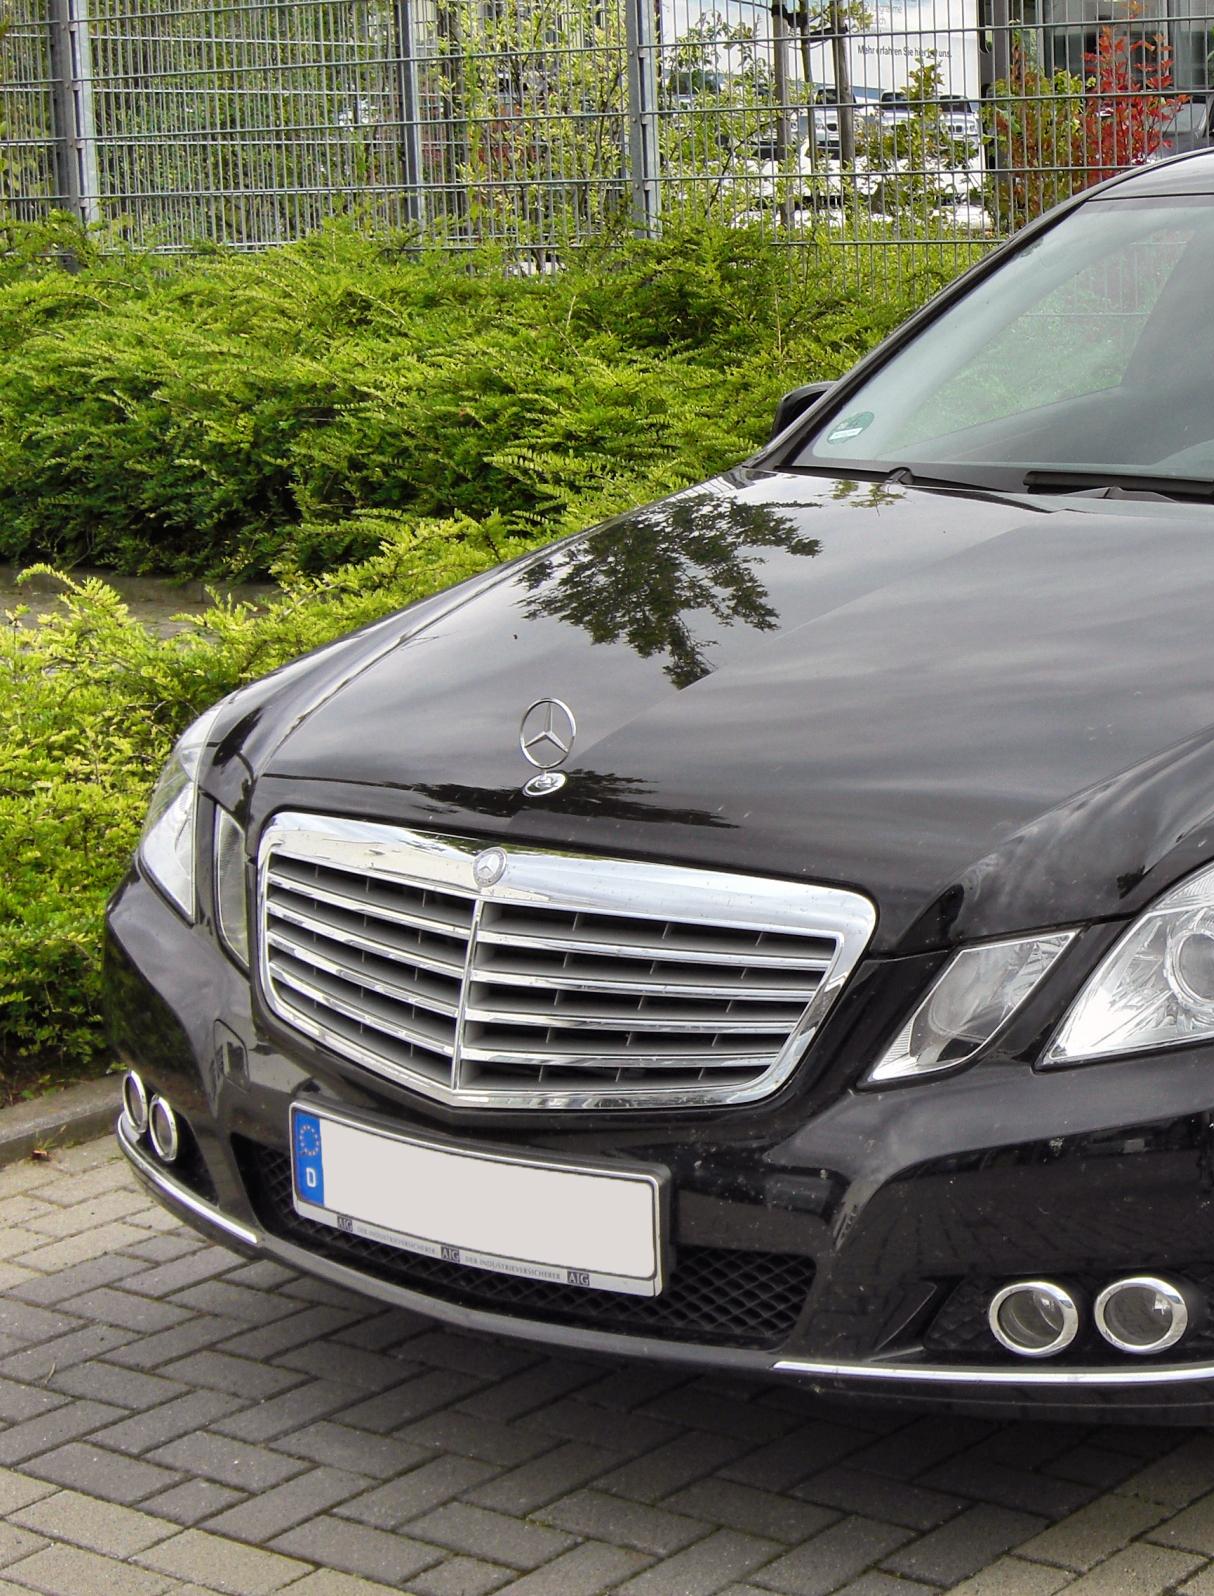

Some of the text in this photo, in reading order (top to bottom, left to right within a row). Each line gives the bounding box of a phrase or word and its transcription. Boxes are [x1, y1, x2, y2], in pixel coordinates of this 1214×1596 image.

[306, 1167, 316, 1188] D
[441, 1246, 460, 1263] AIG
[568, 1272, 590, 1286] AIG
